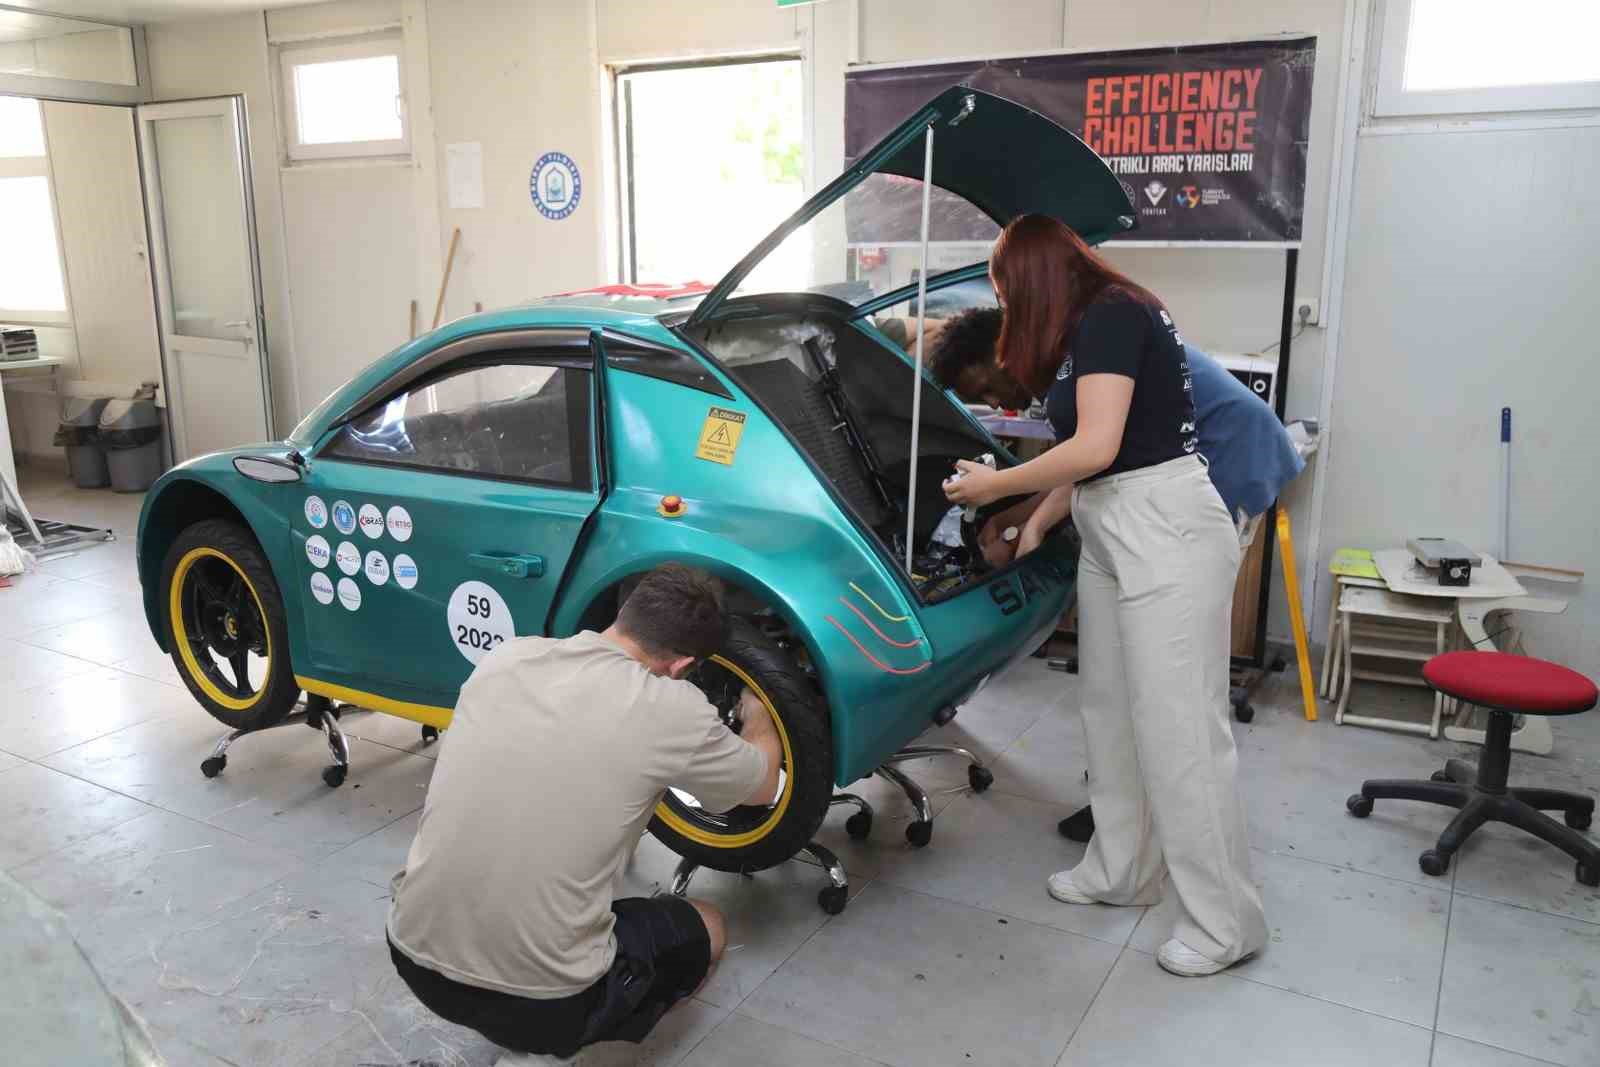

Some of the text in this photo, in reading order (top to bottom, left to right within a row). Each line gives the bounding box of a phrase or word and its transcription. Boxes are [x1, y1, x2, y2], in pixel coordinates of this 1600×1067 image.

[1086, 67, 1262, 116] EFFICIENCY
[1083, 111, 1257, 155] CHALLENGE
[467, 594, 491, 619] 59
